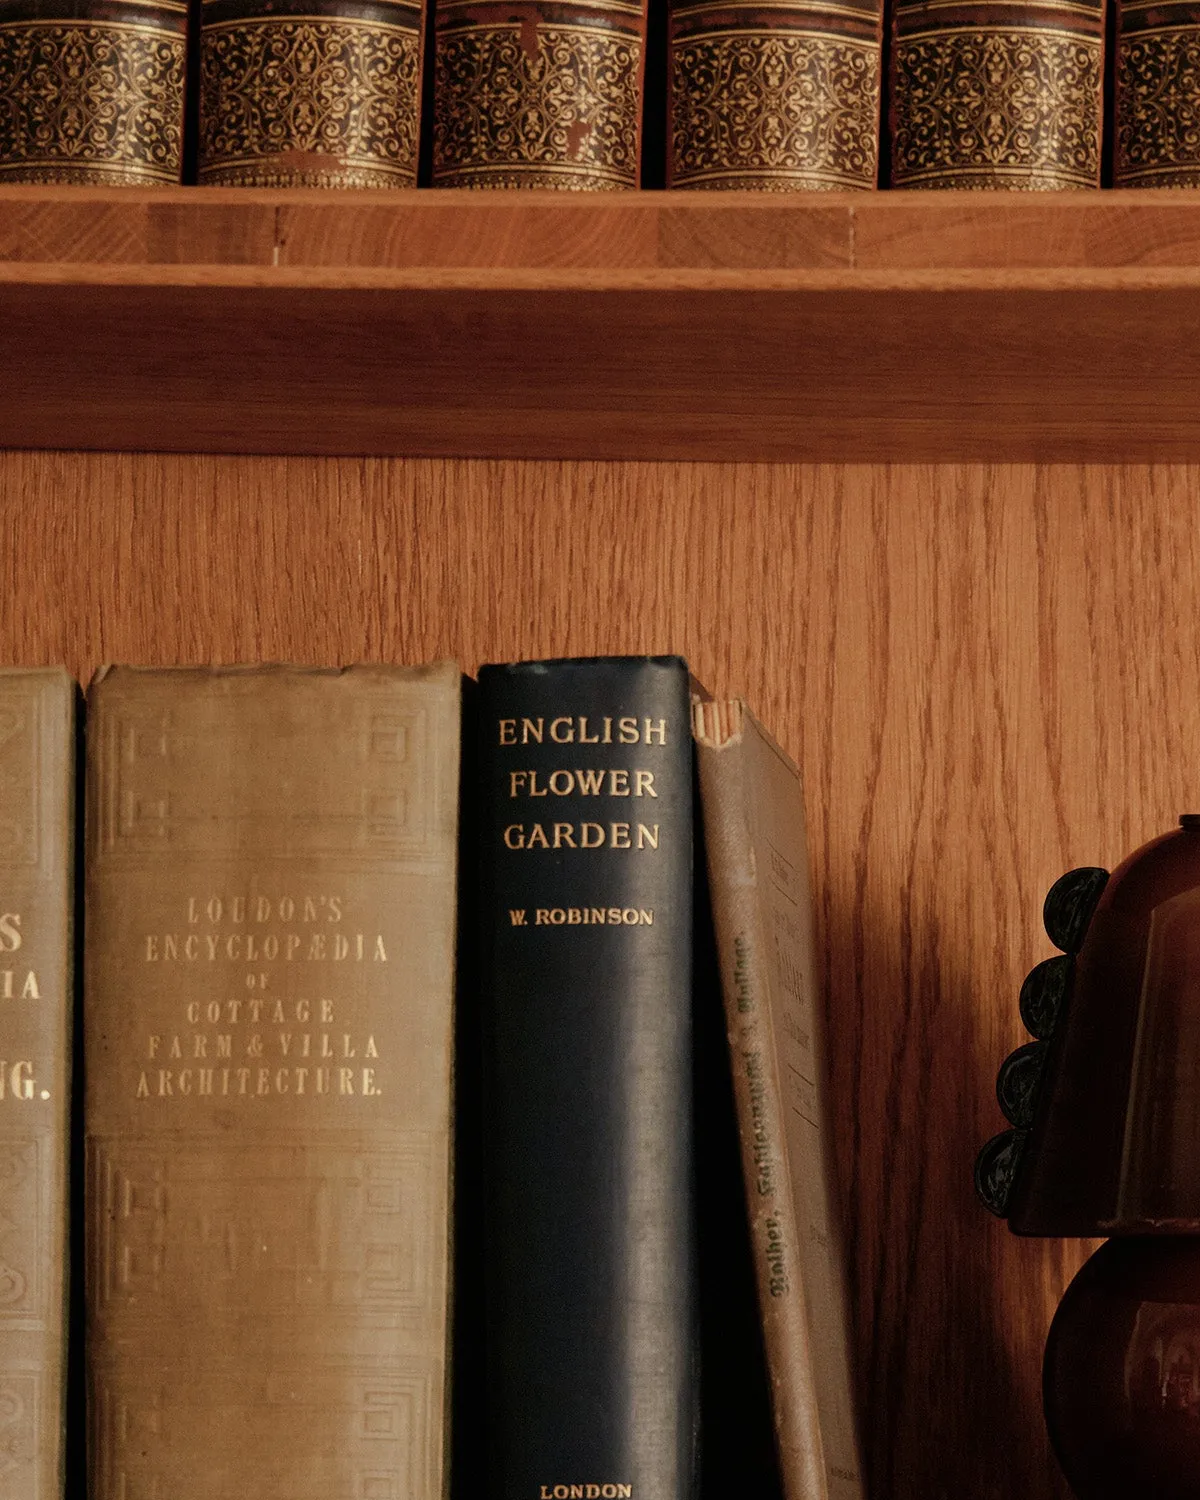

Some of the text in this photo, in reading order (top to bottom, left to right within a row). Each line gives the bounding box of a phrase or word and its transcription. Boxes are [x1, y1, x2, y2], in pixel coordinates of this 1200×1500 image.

[499, 717, 667, 745] ENGLISH
[510, 769, 658, 798] FLOWER
[504, 822, 659, 849] GARDEN
[188, 896, 343, 923] LOUDON'S
[509, 908, 655, 926] W. ROBINSON
[145, 934, 388, 962] ENCYCLOPÆDIA
[245, 973, 269, 990] OF
[187, 1000, 334, 1024] COTTAGE
[148, 1034, 380, 1059] FARM & VILLA
[0, 1060, 50, 1100] G.
[136, 1067, 383, 1098] ARCHITECTURE.
[540, 1483, 632, 1500] LONDON
